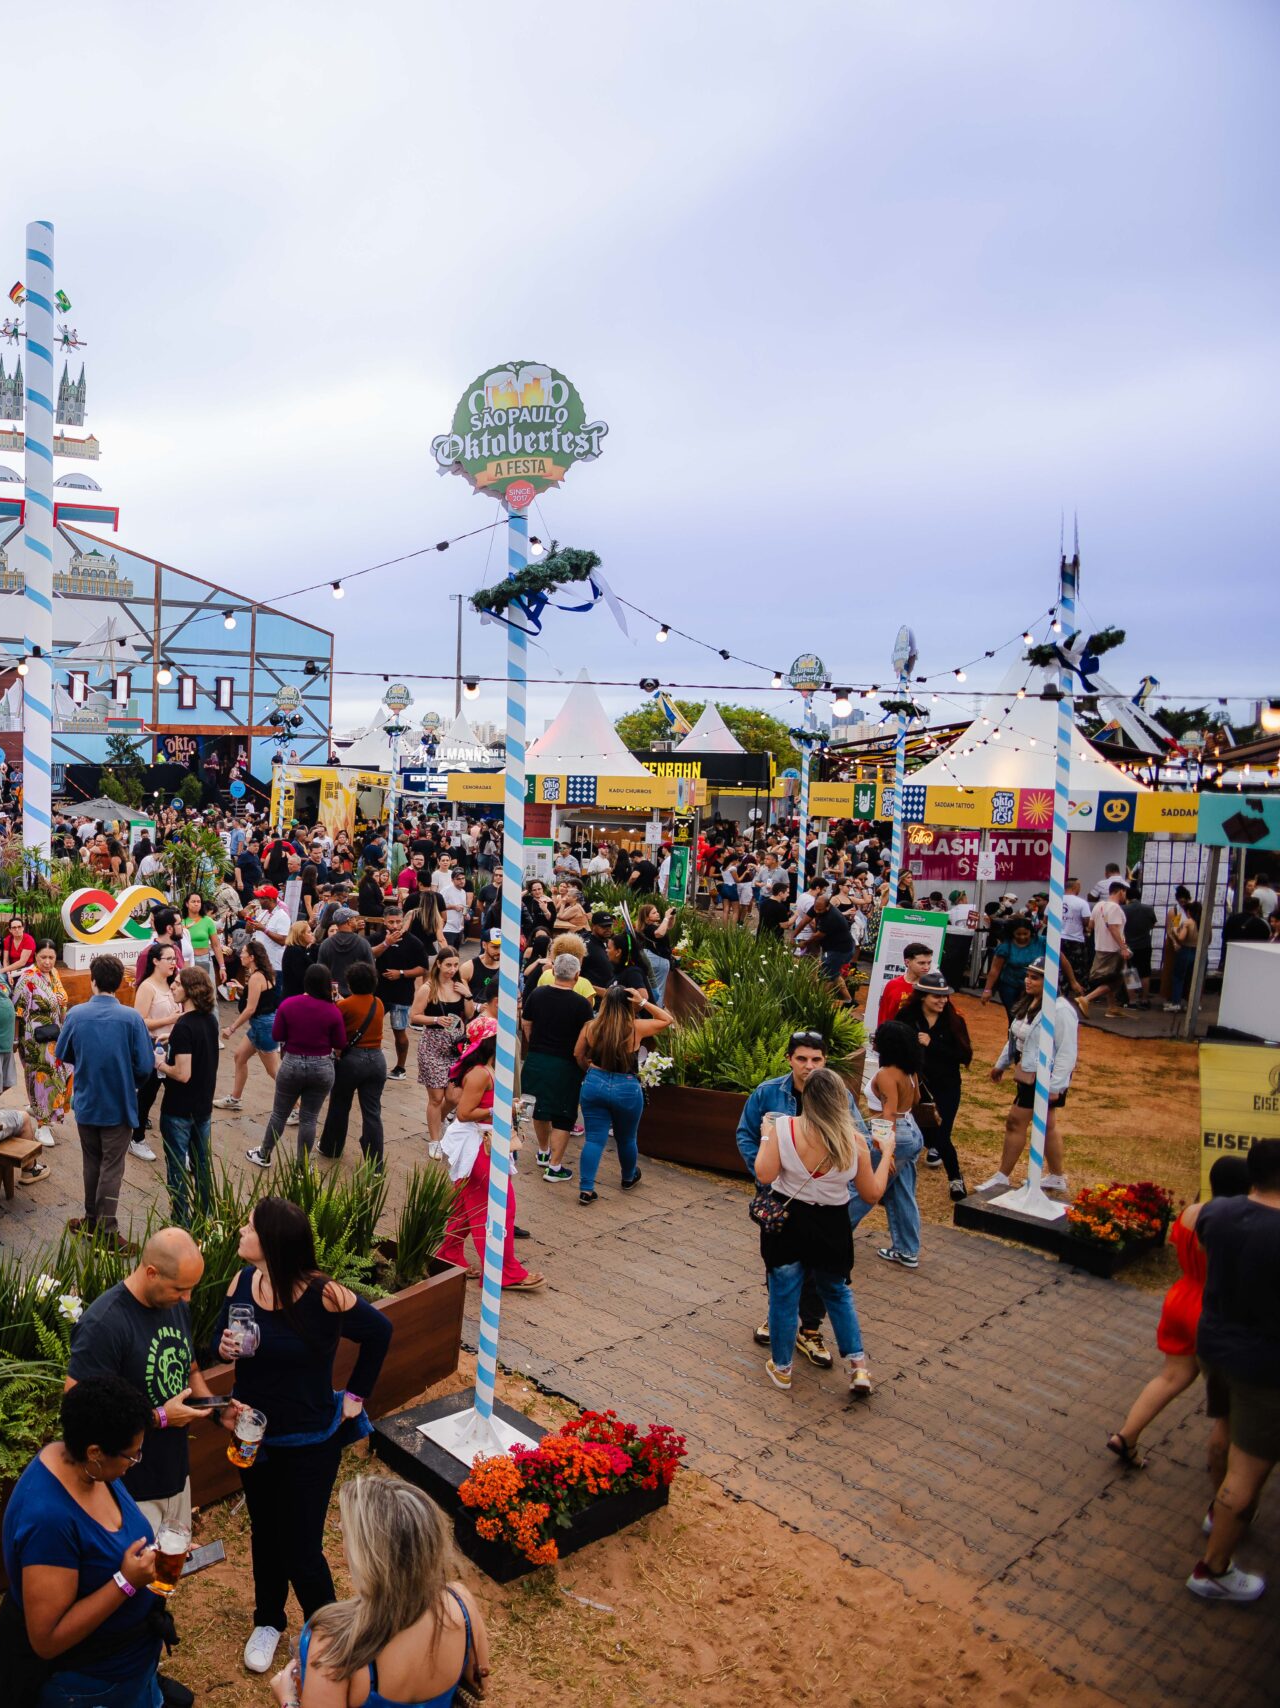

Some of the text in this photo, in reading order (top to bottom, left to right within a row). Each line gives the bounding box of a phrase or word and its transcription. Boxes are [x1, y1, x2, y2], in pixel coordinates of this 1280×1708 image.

[470, 406, 569, 431] SÃO PAULO
[432, 421, 609, 467] Oktoberfest
[495, 459, 547, 477] A FESTA
[508, 488, 532, 496] SINCE
[512, 494, 529, 502] 2017
[934, 801, 955, 809] SADDAM
[908, 838, 1054, 857] FLASH TATTO
[145, 1337, 160, 1381] INDIA
[158, 1326, 182, 1340] PALE
